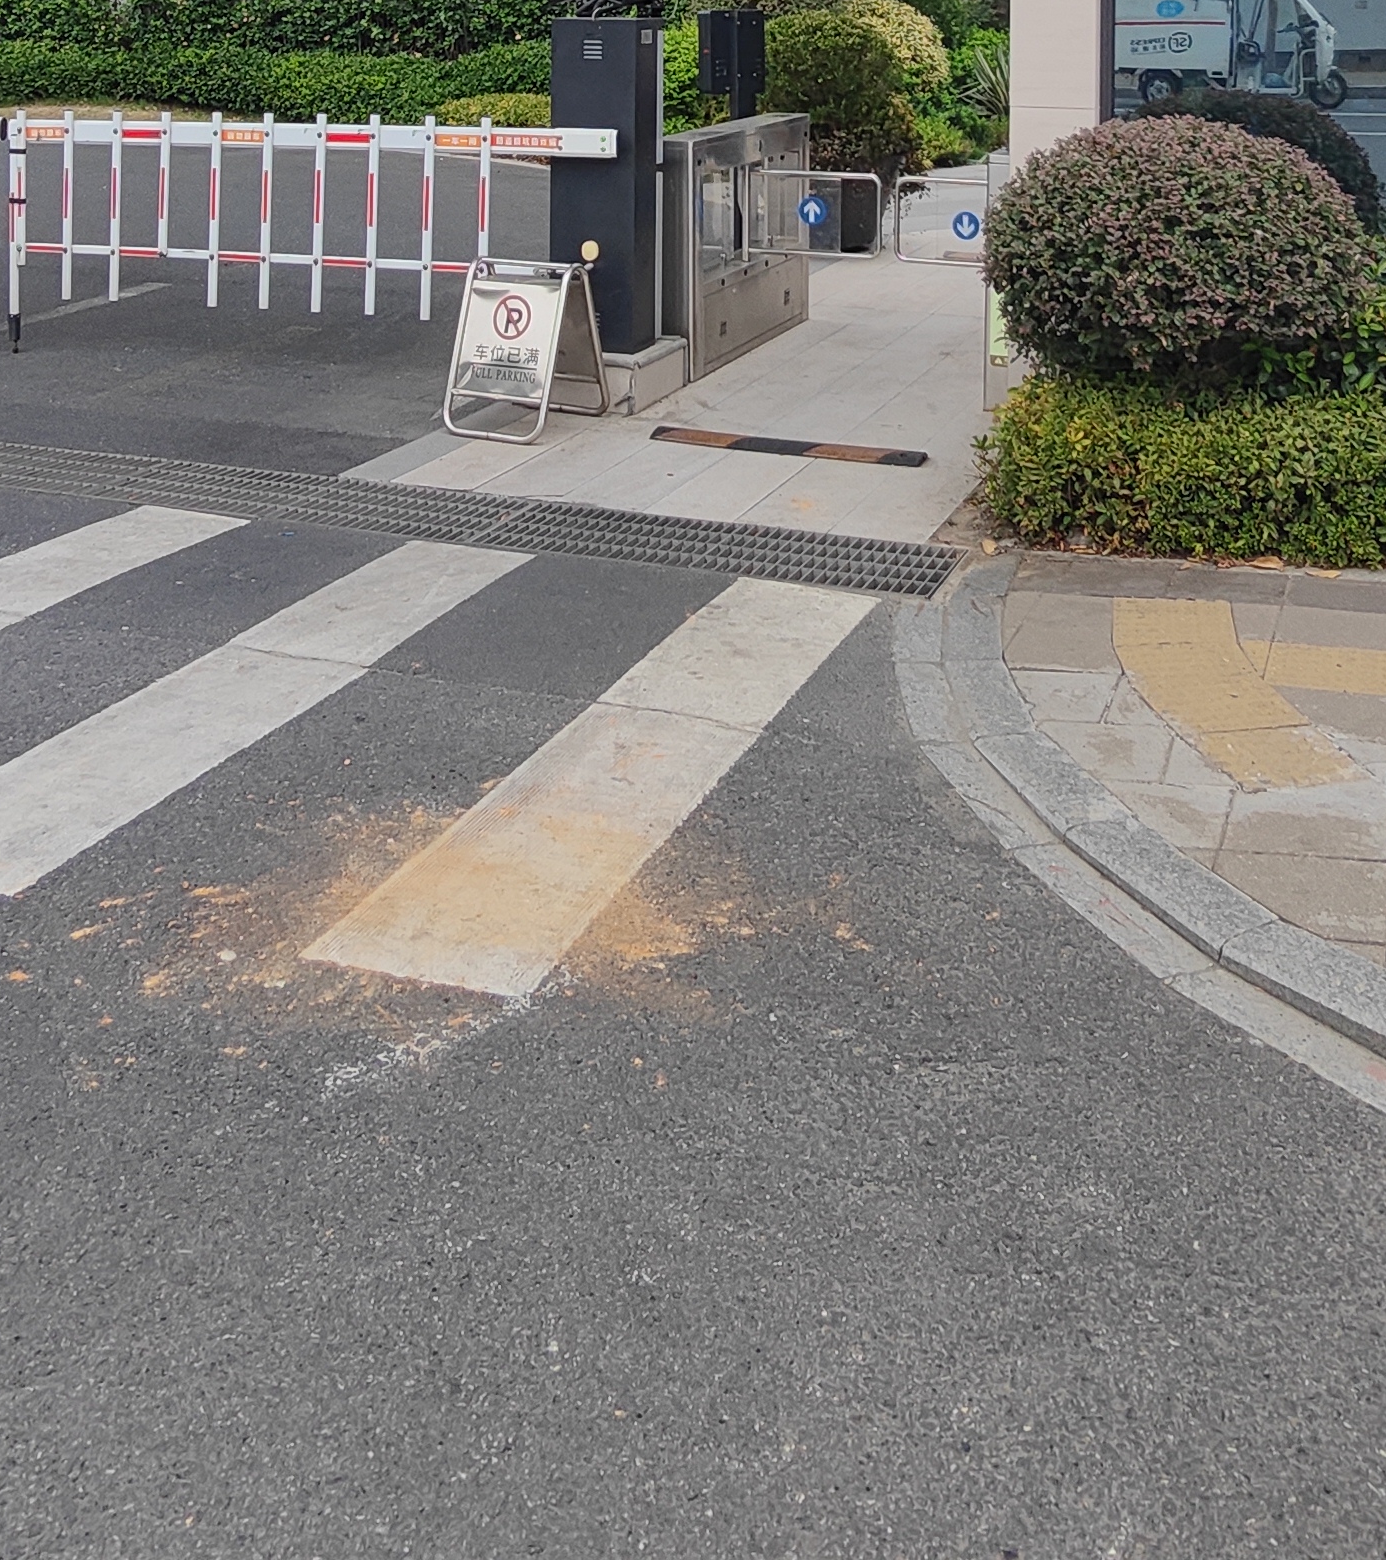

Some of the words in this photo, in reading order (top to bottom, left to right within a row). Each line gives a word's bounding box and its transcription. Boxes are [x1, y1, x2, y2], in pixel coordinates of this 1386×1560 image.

[473, 343, 541, 366] 车位已满
[496, 369, 536, 384] PARKING
